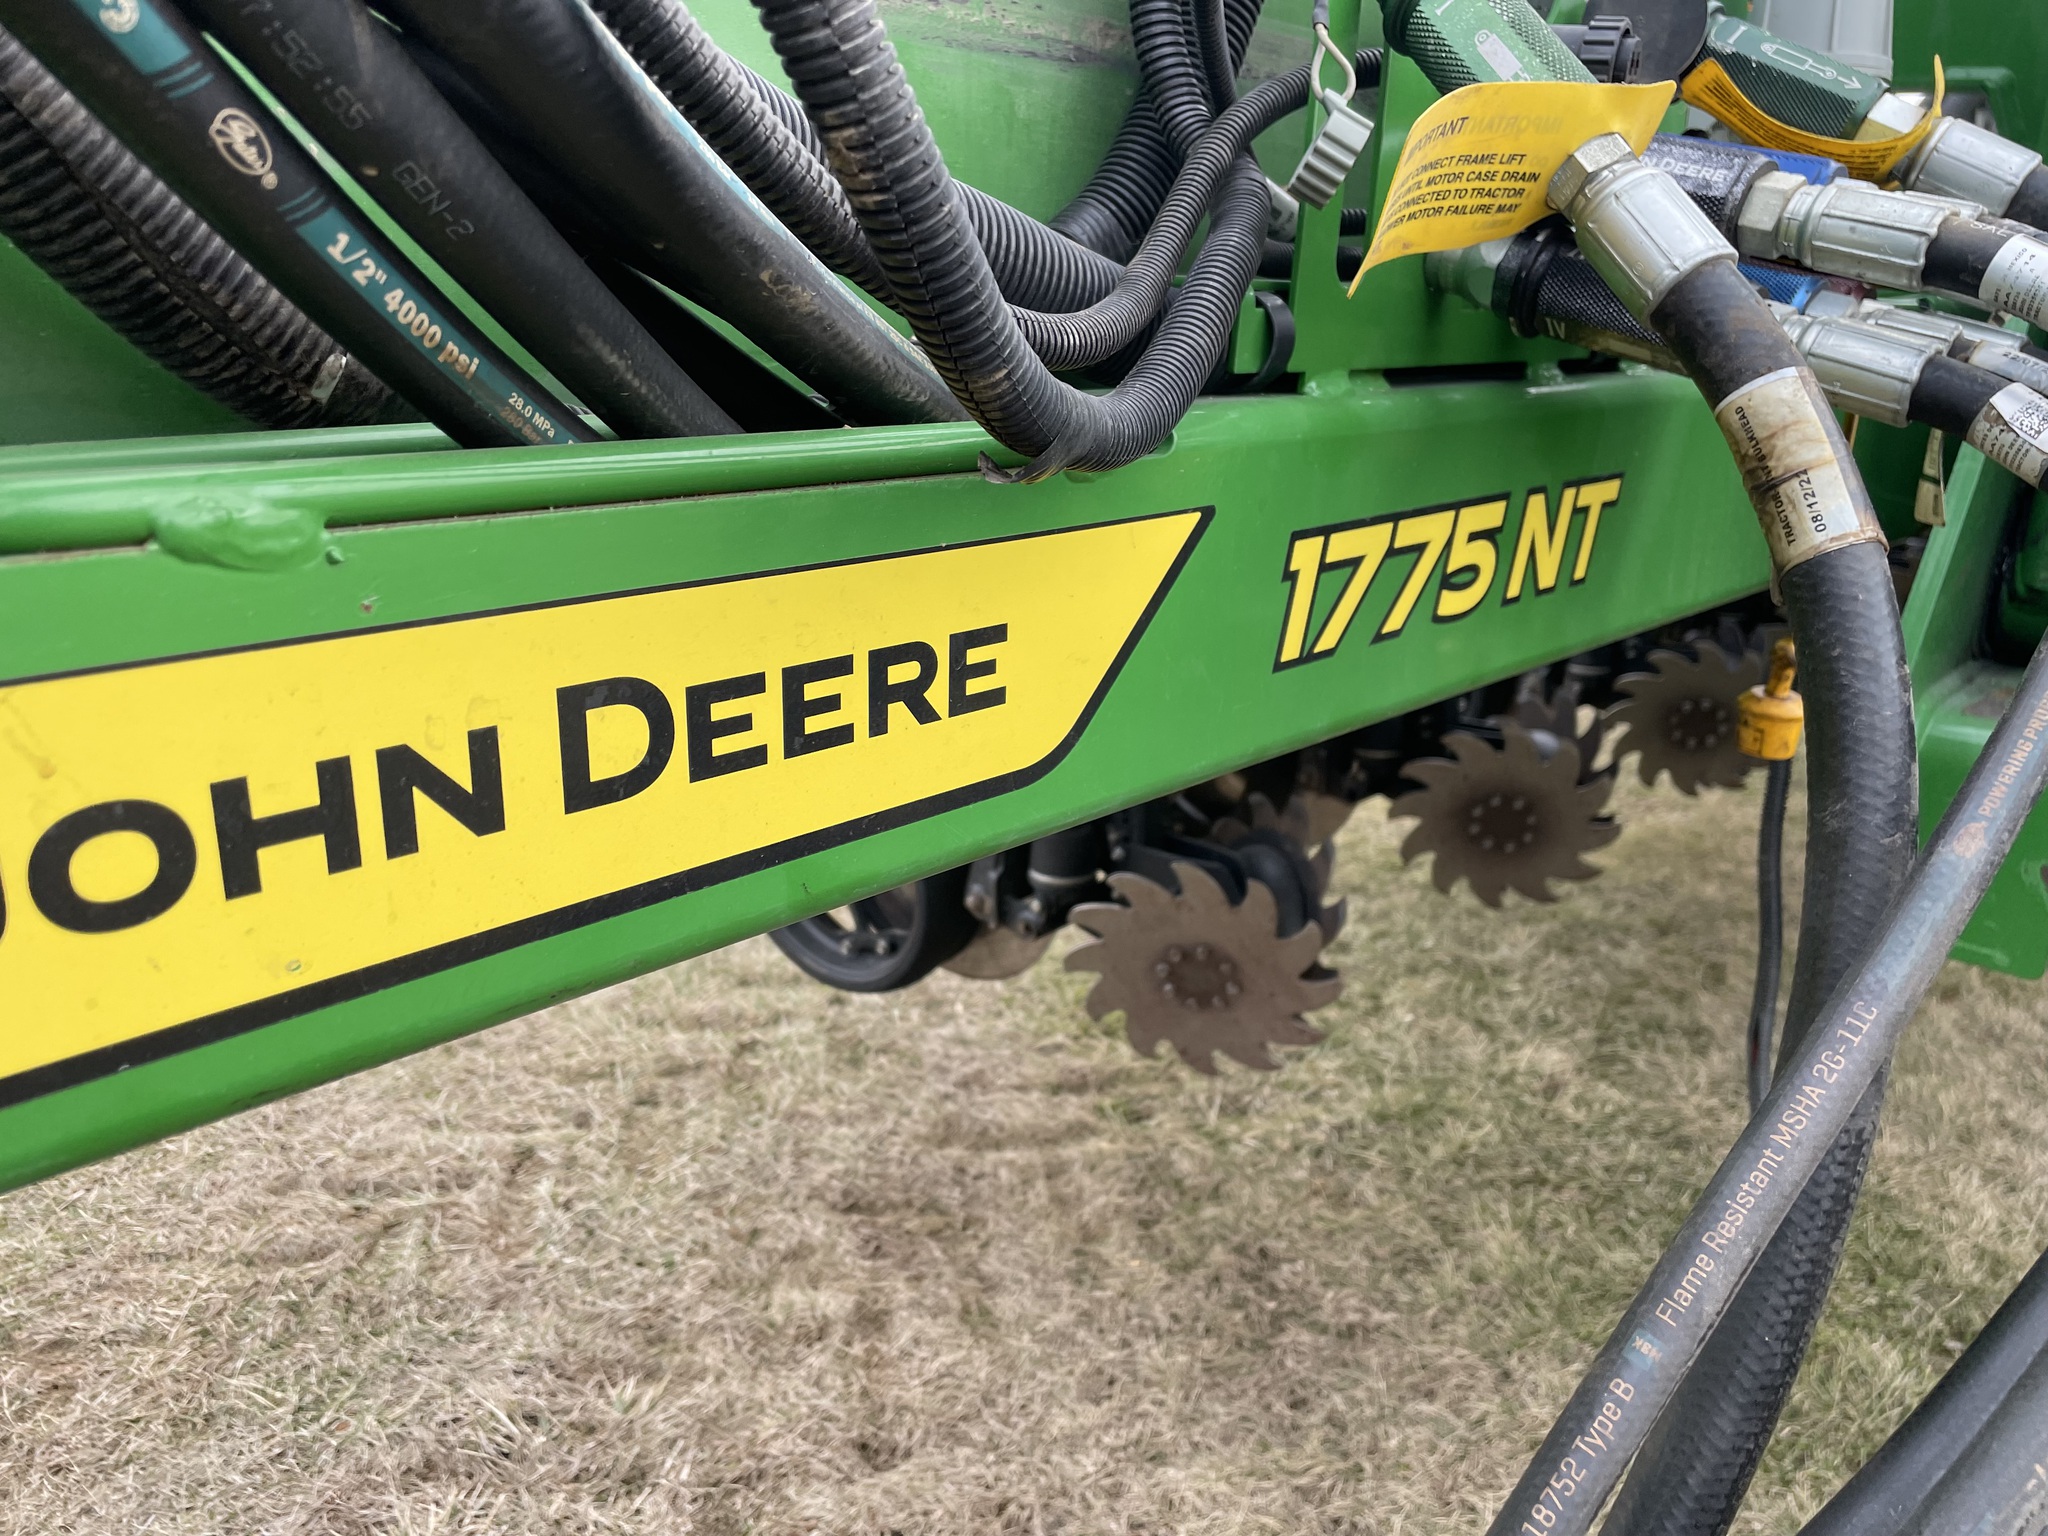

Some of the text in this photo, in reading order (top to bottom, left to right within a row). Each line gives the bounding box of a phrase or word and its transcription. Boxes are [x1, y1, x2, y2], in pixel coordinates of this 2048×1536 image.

[1424, 171, 1463, 189] MOTOR
[1466, 170, 1497, 184] CASE
[1500, 171, 1541, 183] DRAIN
[1456, 153, 1498, 167] FRAME
[1499, 153, 1527, 166] LIFT
[1660, 158, 1729, 182] DEERE
[1406, 203, 1443, 222] MOTOR
[1444, 203, 1495, 216] FAILURE
[1495, 203, 1521, 215] MAY
[1452, 188, 1467, 200] TO
[1469, 187, 1526, 199] TRACTOR
[326, 231, 481, 381] 1/2" 4000 psi
[508, 392, 556, 438] 28.0 MPa
[1734, 405, 1768, 464] BULKHEAD
[1274, 473, 1624, 672] 1775 NT
[0, 622, 1009, 938] OHN DEERE
[1977, 739, 2034, 818] POWERING
[1655, 1253, 1715, 1328] Flame
[1701, 1147, 1785, 1256] Resistant
[1769, 1084, 1827, 1150] MSHA
[1521, 1376, 1636, 1536] 18752 Type B
